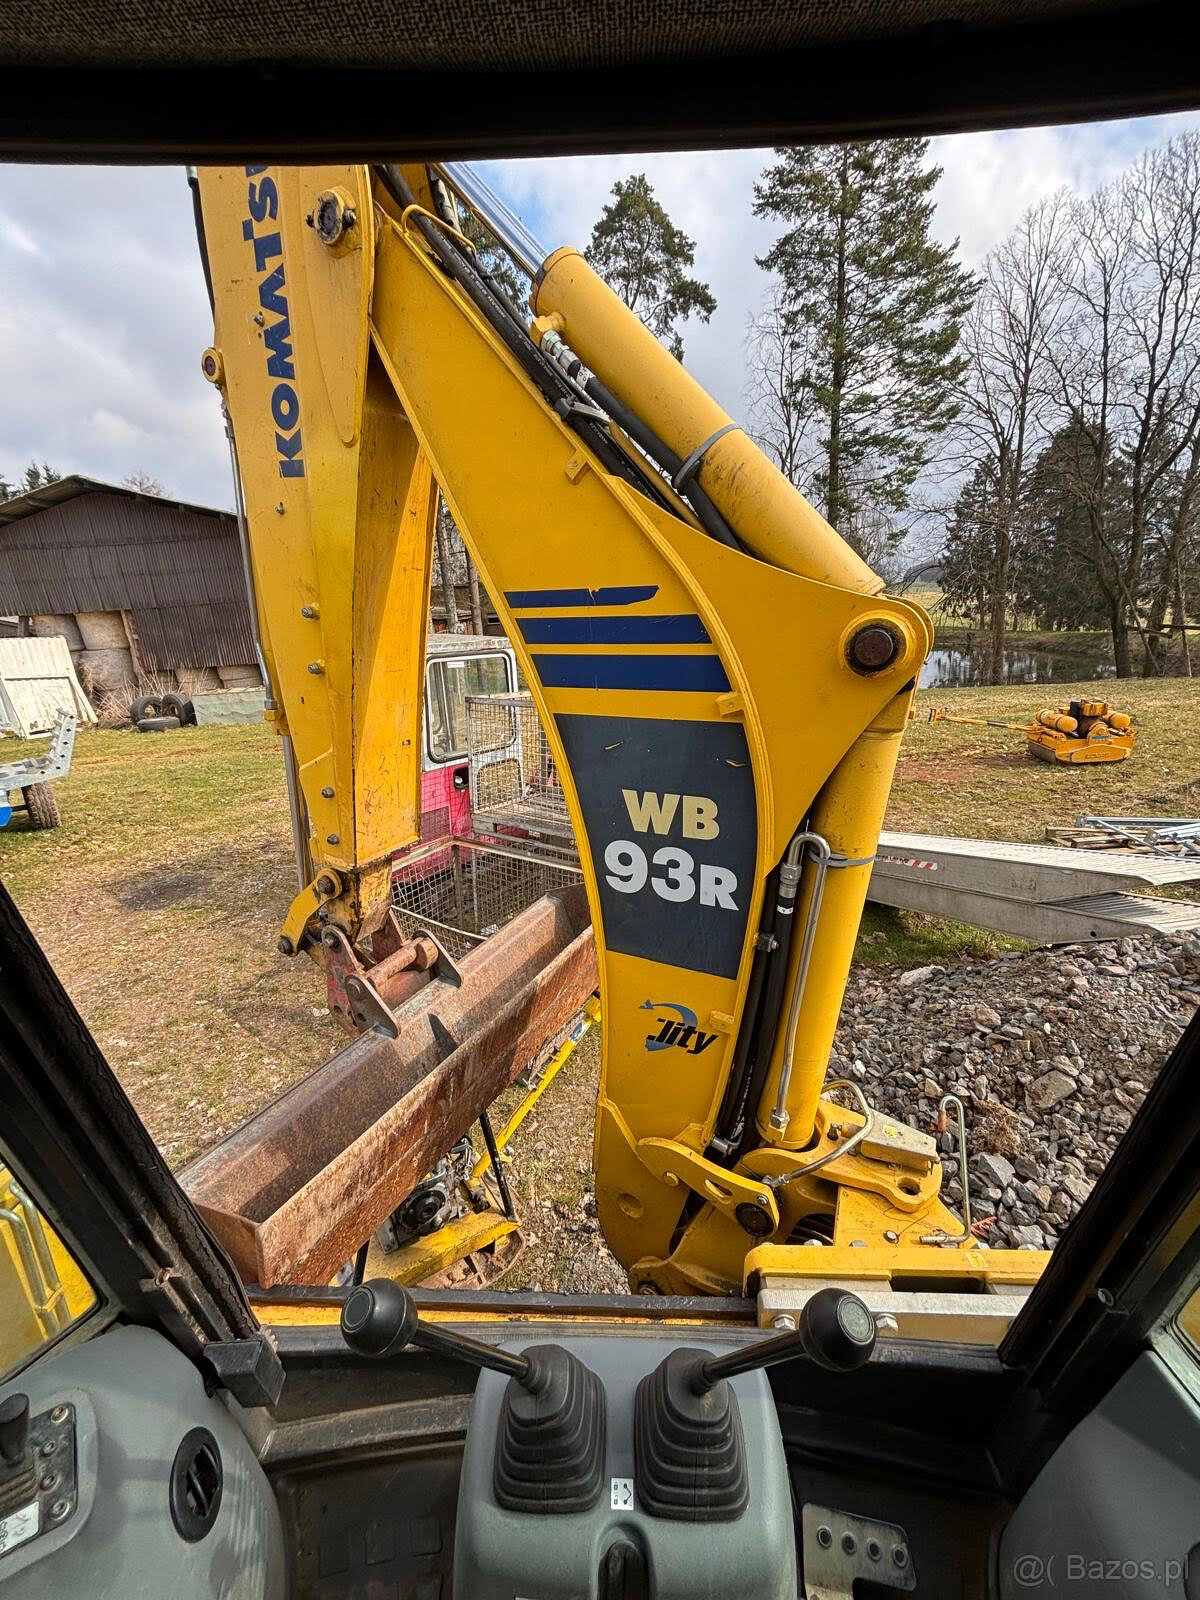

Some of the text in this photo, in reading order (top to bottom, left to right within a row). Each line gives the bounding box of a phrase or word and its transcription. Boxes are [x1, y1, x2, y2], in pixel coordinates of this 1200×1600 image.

[242, 165, 305, 478] KOMATS
[621, 788, 720, 841] WB
[604, 839, 740, 912] 93R
